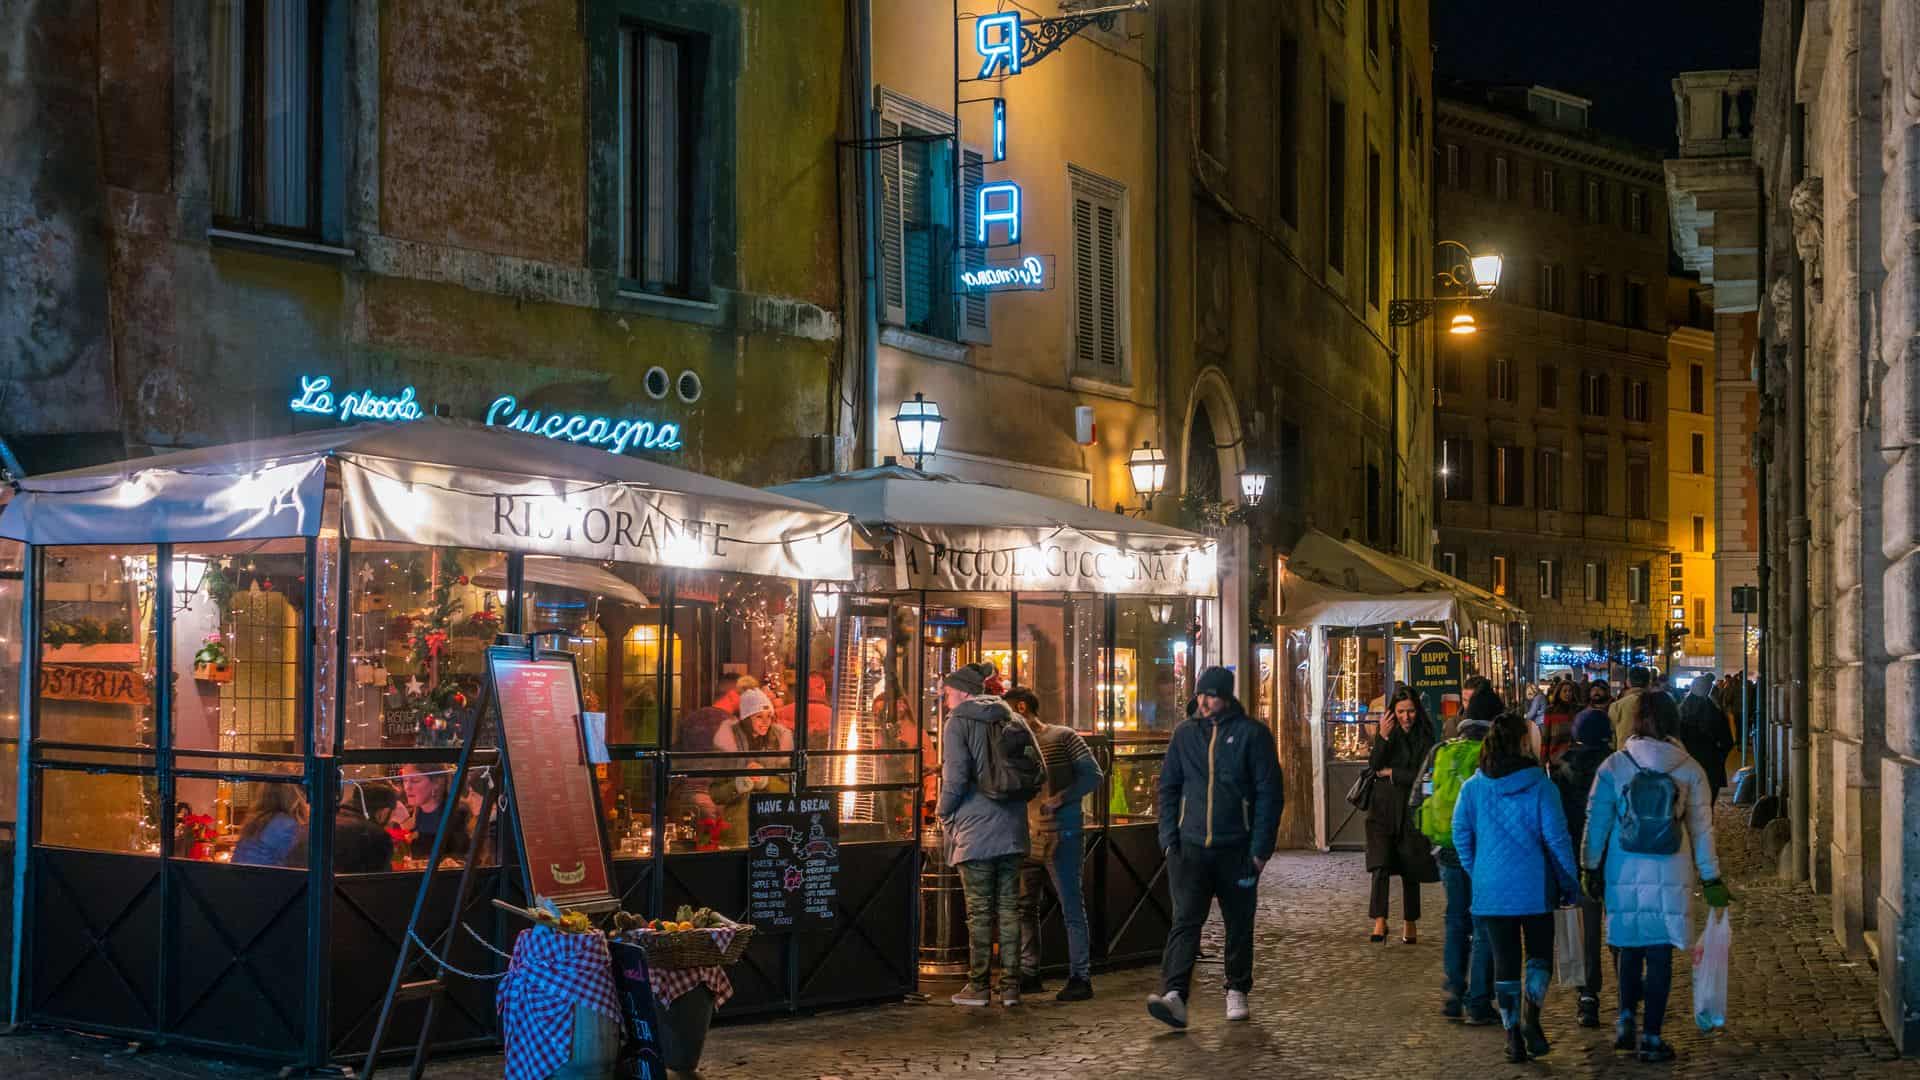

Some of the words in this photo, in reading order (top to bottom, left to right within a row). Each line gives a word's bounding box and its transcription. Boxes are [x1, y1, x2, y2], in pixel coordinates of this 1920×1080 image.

[290, 375, 335, 413] La
[485, 395, 681, 455] Cuccagna
[492, 492, 731, 557] RITORANTE
[932, 544, 1037, 577] PICCOL
[1046, 545, 1167, 580] CUCCGNA
[1420, 652, 1449, 663] HAPPY
[1424, 664, 1448, 676] HOUR
[757, 800, 782, 814] HAVE
[788, 799, 796, 812] A
[800, 799, 830, 813] BREAK
